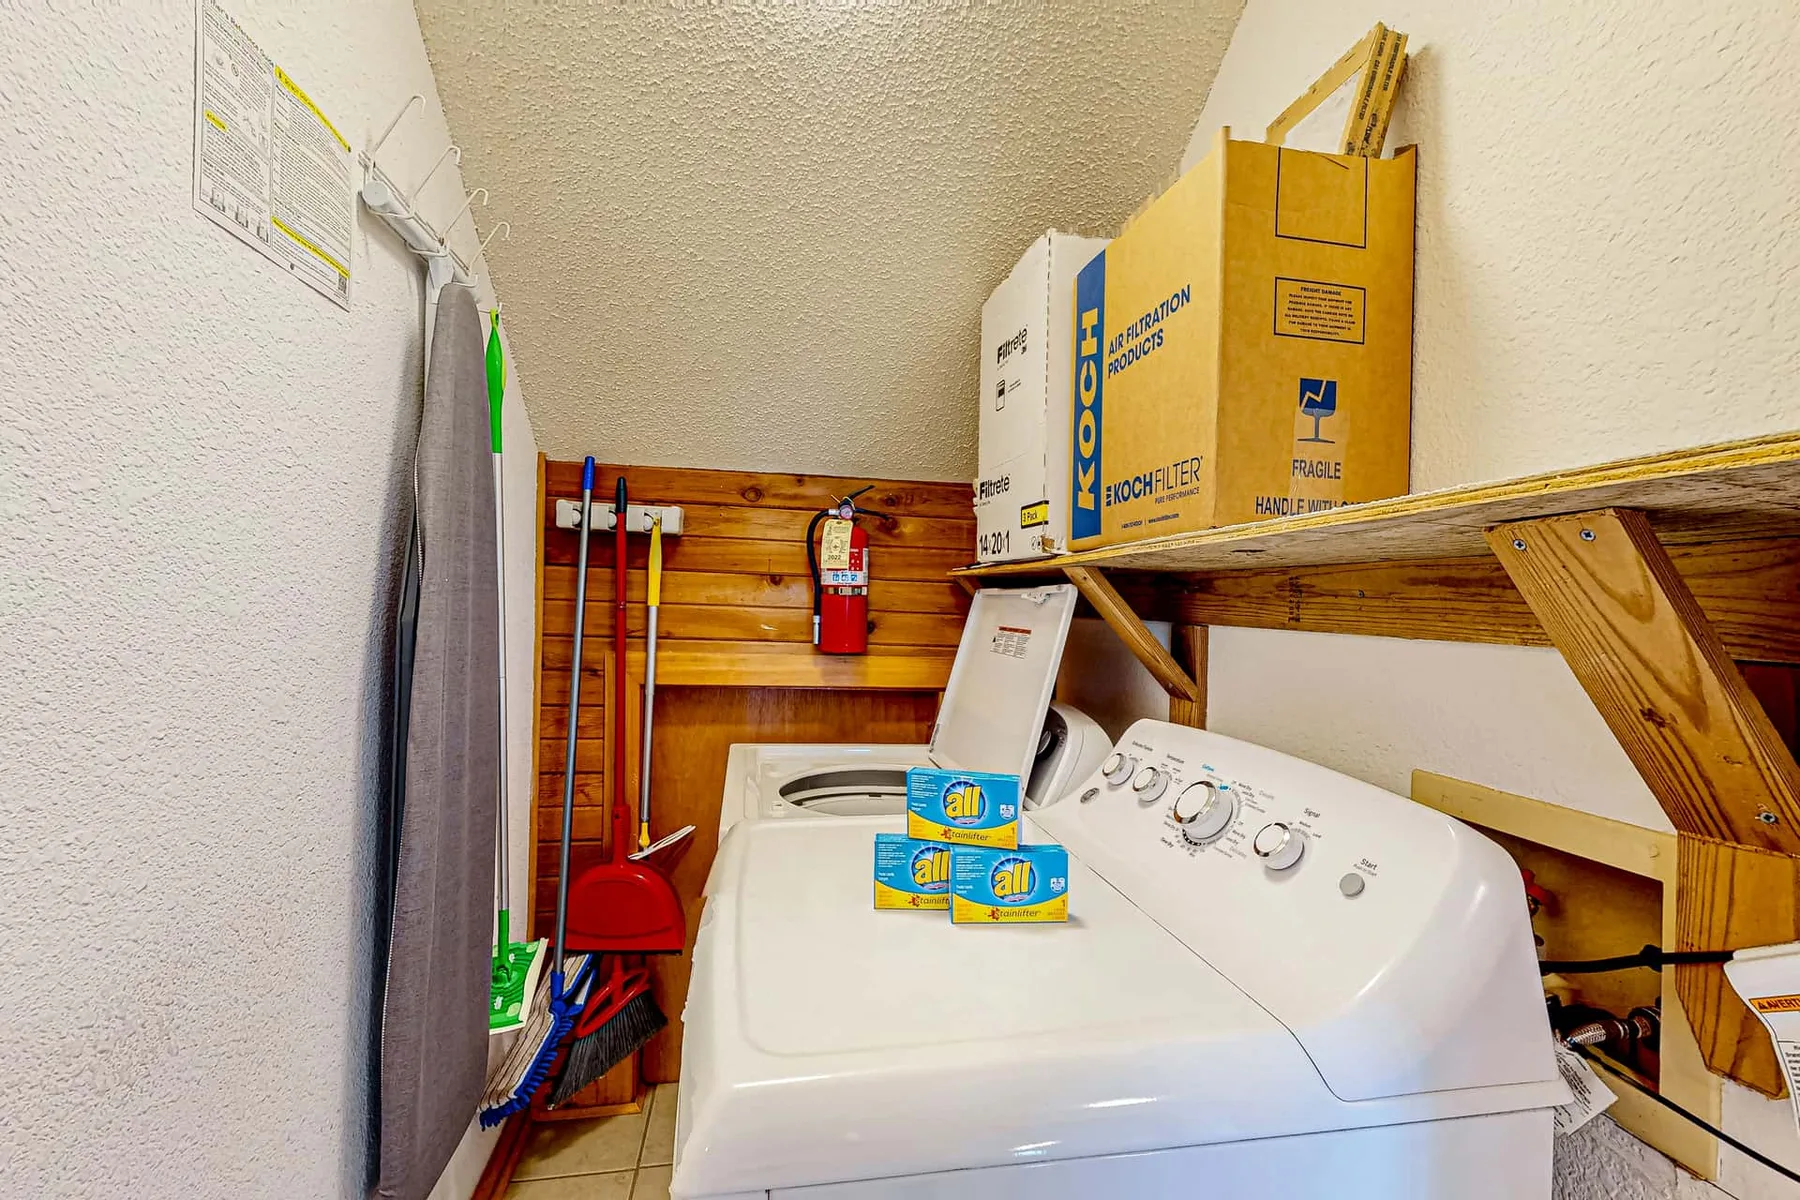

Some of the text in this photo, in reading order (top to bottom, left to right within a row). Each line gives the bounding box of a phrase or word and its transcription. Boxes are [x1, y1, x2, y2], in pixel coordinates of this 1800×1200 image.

[1108, 284, 1190, 357] AIR FILTRATION
[997, 328, 1028, 364] Filtrete
[1108, 328, 1164, 379] PRODUCTS
[1078, 307, 1098, 510] KOCH
[1292, 459, 1341, 479] FRAGILE
[980, 474, 1010, 500] Filtrete
[1166, 486, 1200, 502] PERFORMANCE
[1027, 510, 1038, 521] Pack
[1256, 496, 1304, 515] HANDLE
[946, 785, 981, 818] all
[1304, 808, 1320, 818] Signal
[914, 850, 950, 884] all
[1360, 858, 1377, 870] Start
[994, 861, 1032, 897] all
